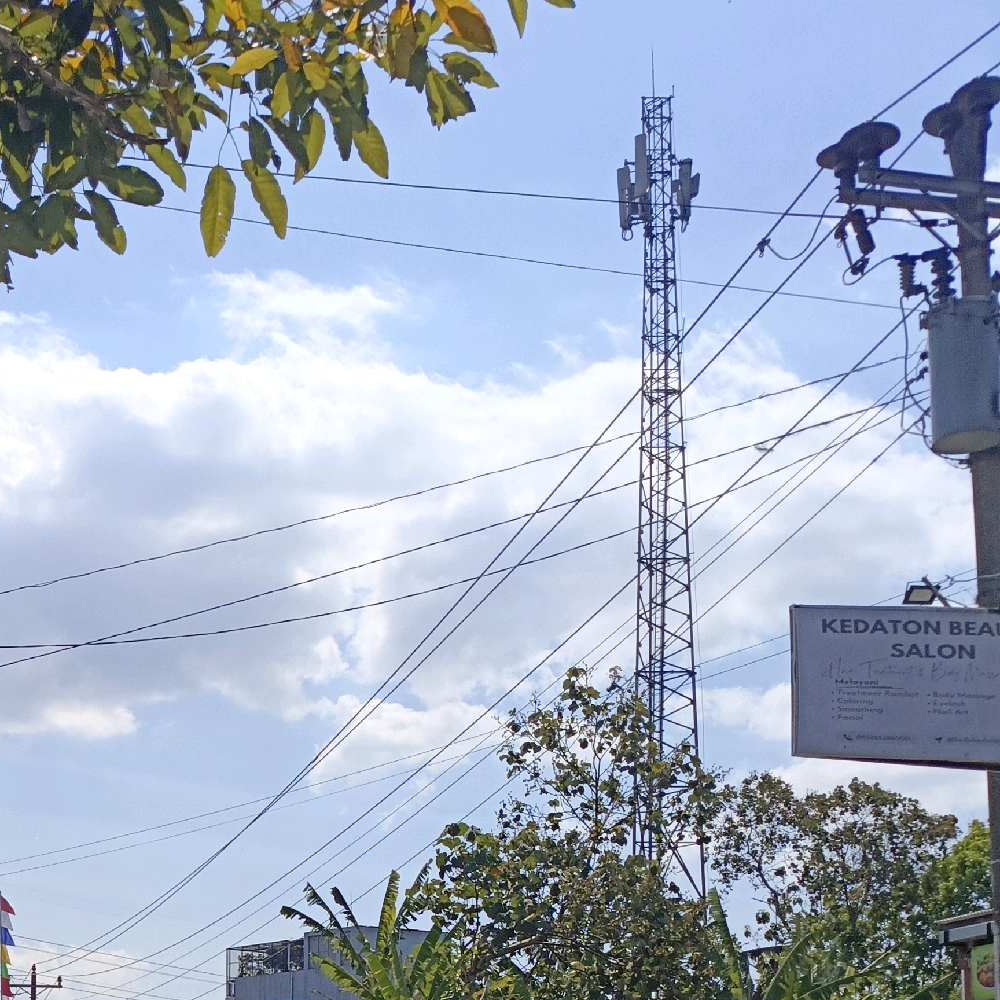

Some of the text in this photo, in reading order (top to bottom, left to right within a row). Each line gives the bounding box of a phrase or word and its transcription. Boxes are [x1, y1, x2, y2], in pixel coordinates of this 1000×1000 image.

[821, 619, 941, 635] KEDATON
[890, 643, 976, 660] SALON
[835, 678, 879, 686] Melayani
